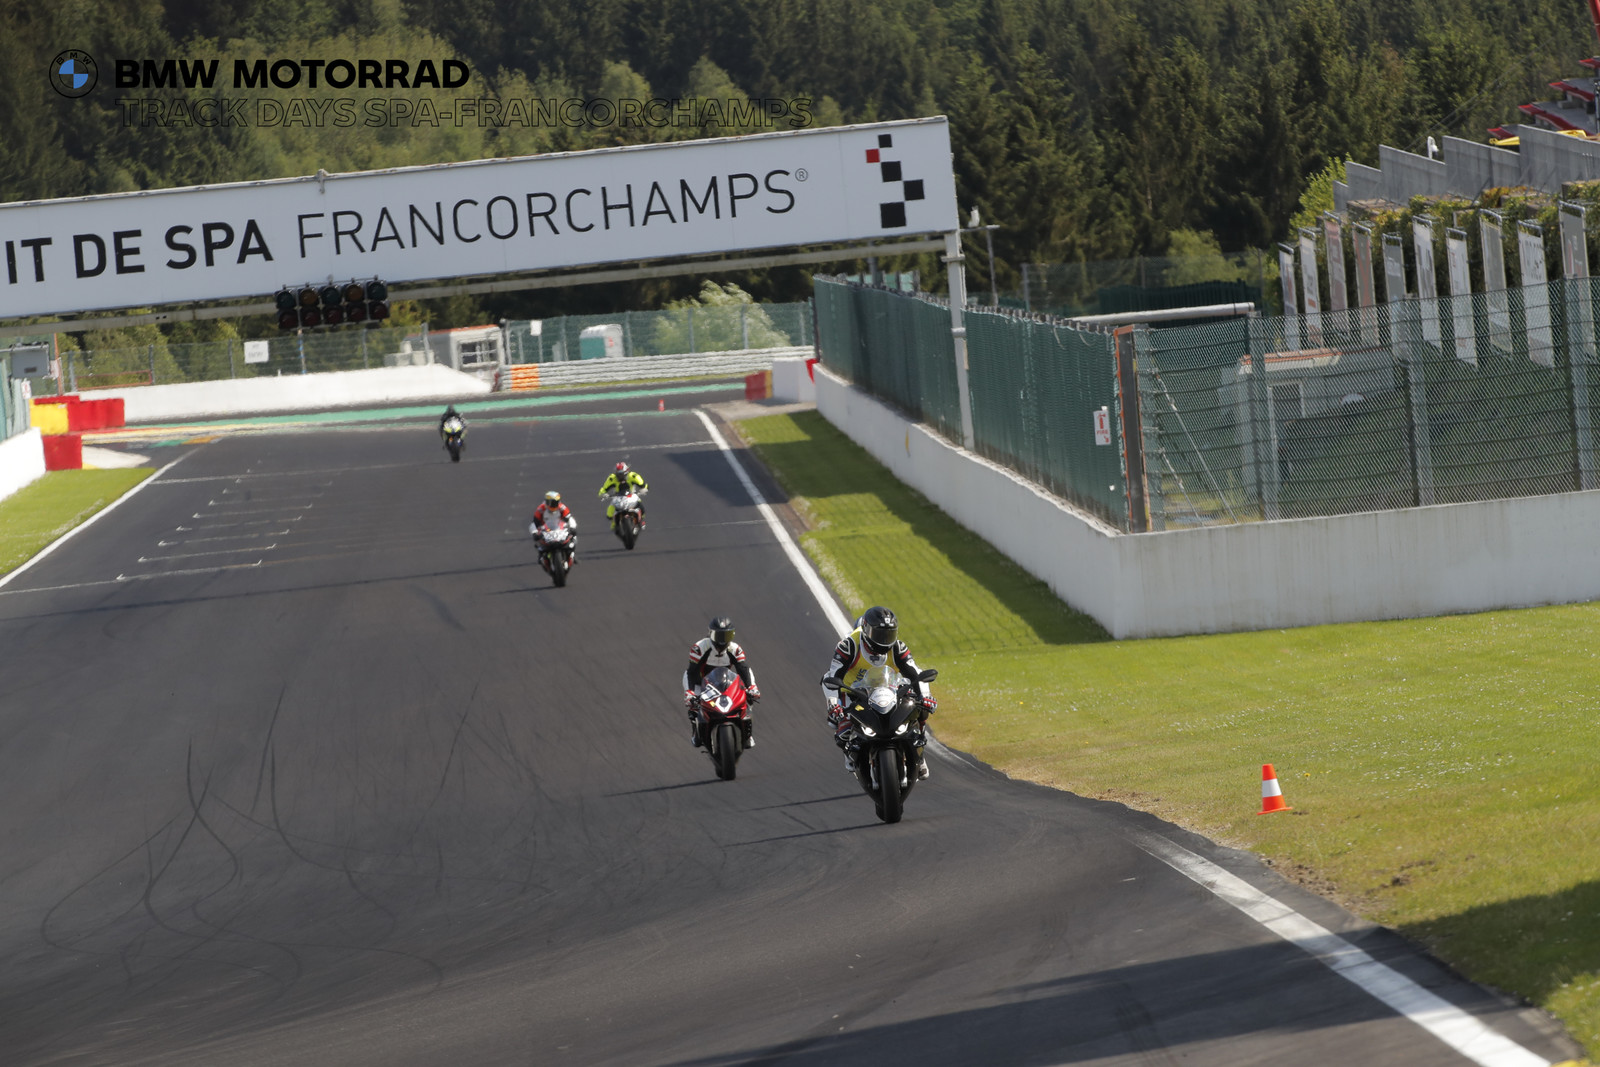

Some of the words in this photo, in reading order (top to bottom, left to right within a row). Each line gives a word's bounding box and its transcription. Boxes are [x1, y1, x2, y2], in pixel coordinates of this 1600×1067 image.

[6, 237, 52, 284] IT
[73, 230, 145, 278] DE
[165, 219, 274, 270] SPA
